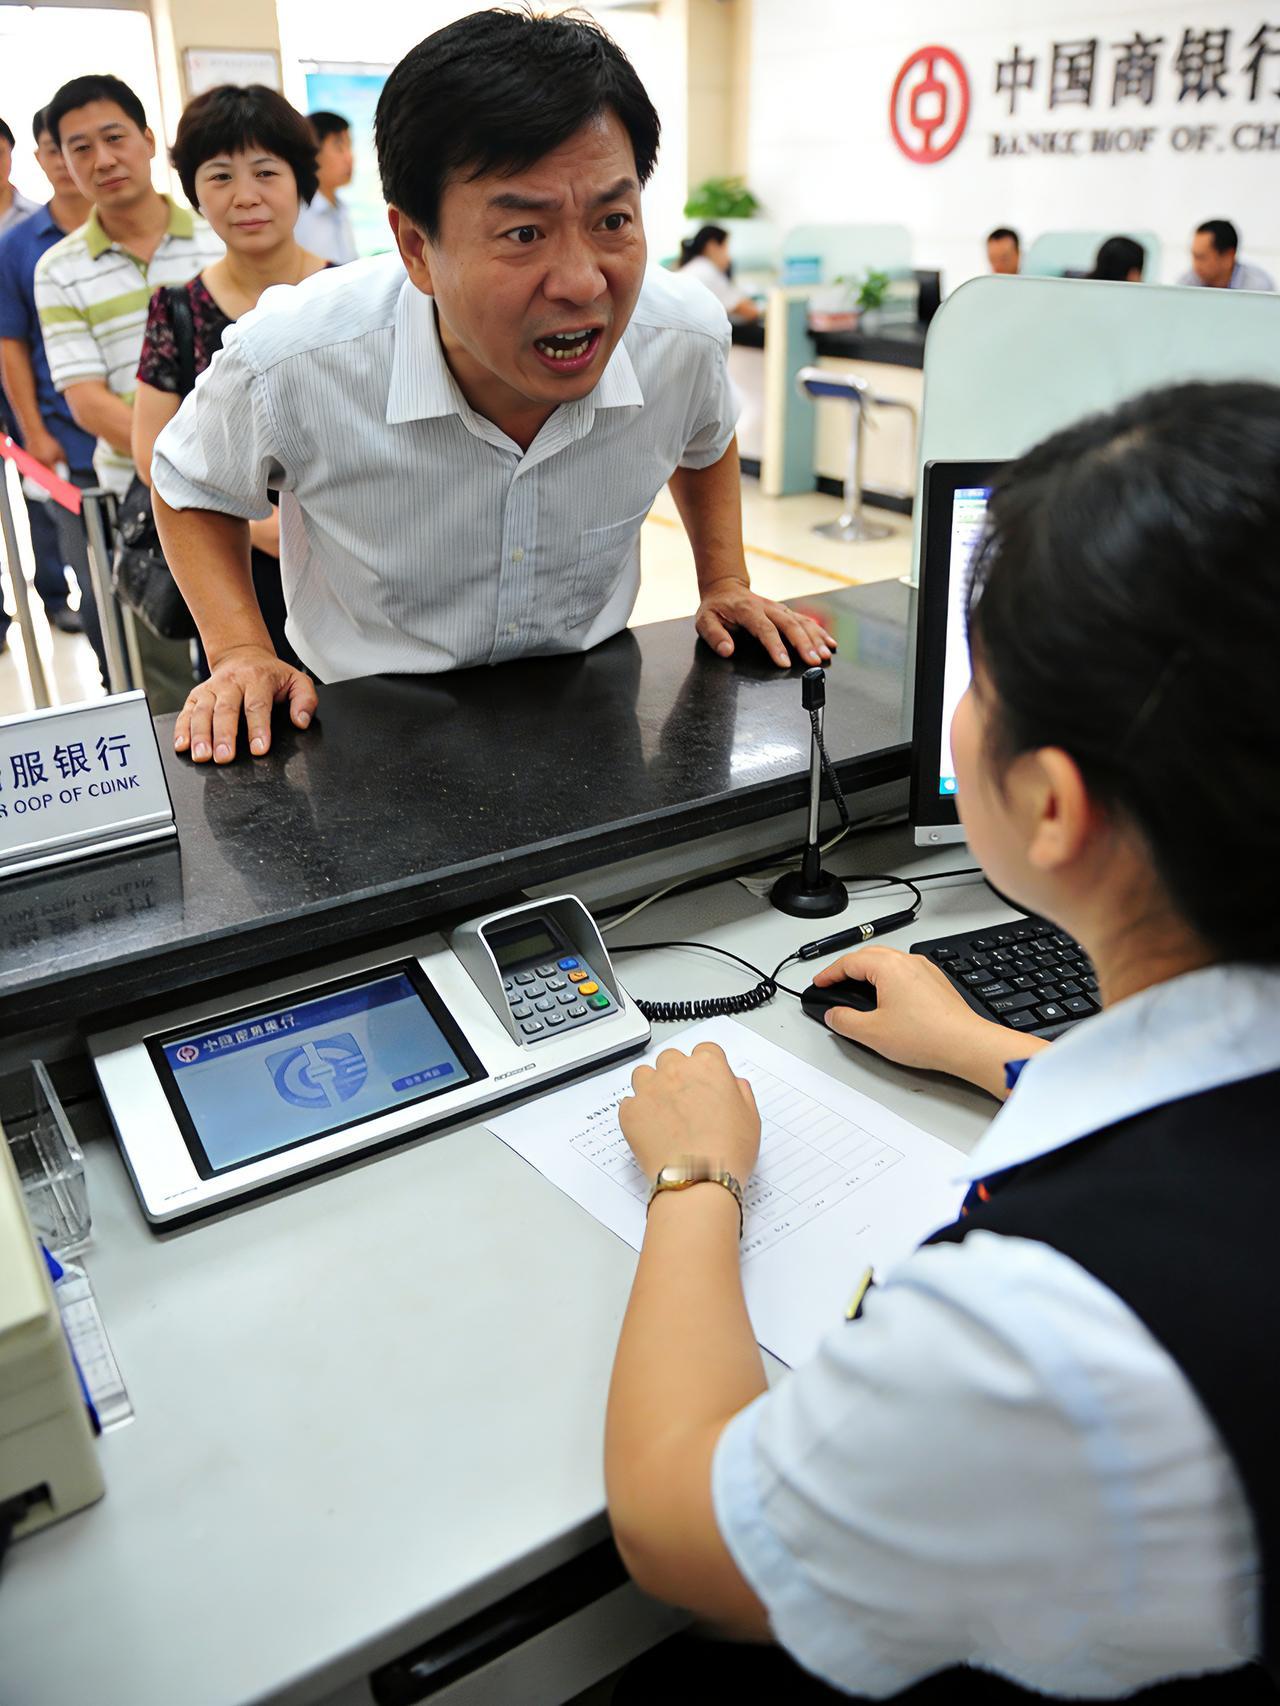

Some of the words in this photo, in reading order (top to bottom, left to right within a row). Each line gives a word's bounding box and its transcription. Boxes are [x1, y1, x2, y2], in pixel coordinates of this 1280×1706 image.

[0, 735, 131, 791] 服银行
[14, 793, 53, 814] OOP
[59, 787, 83, 804] OF
